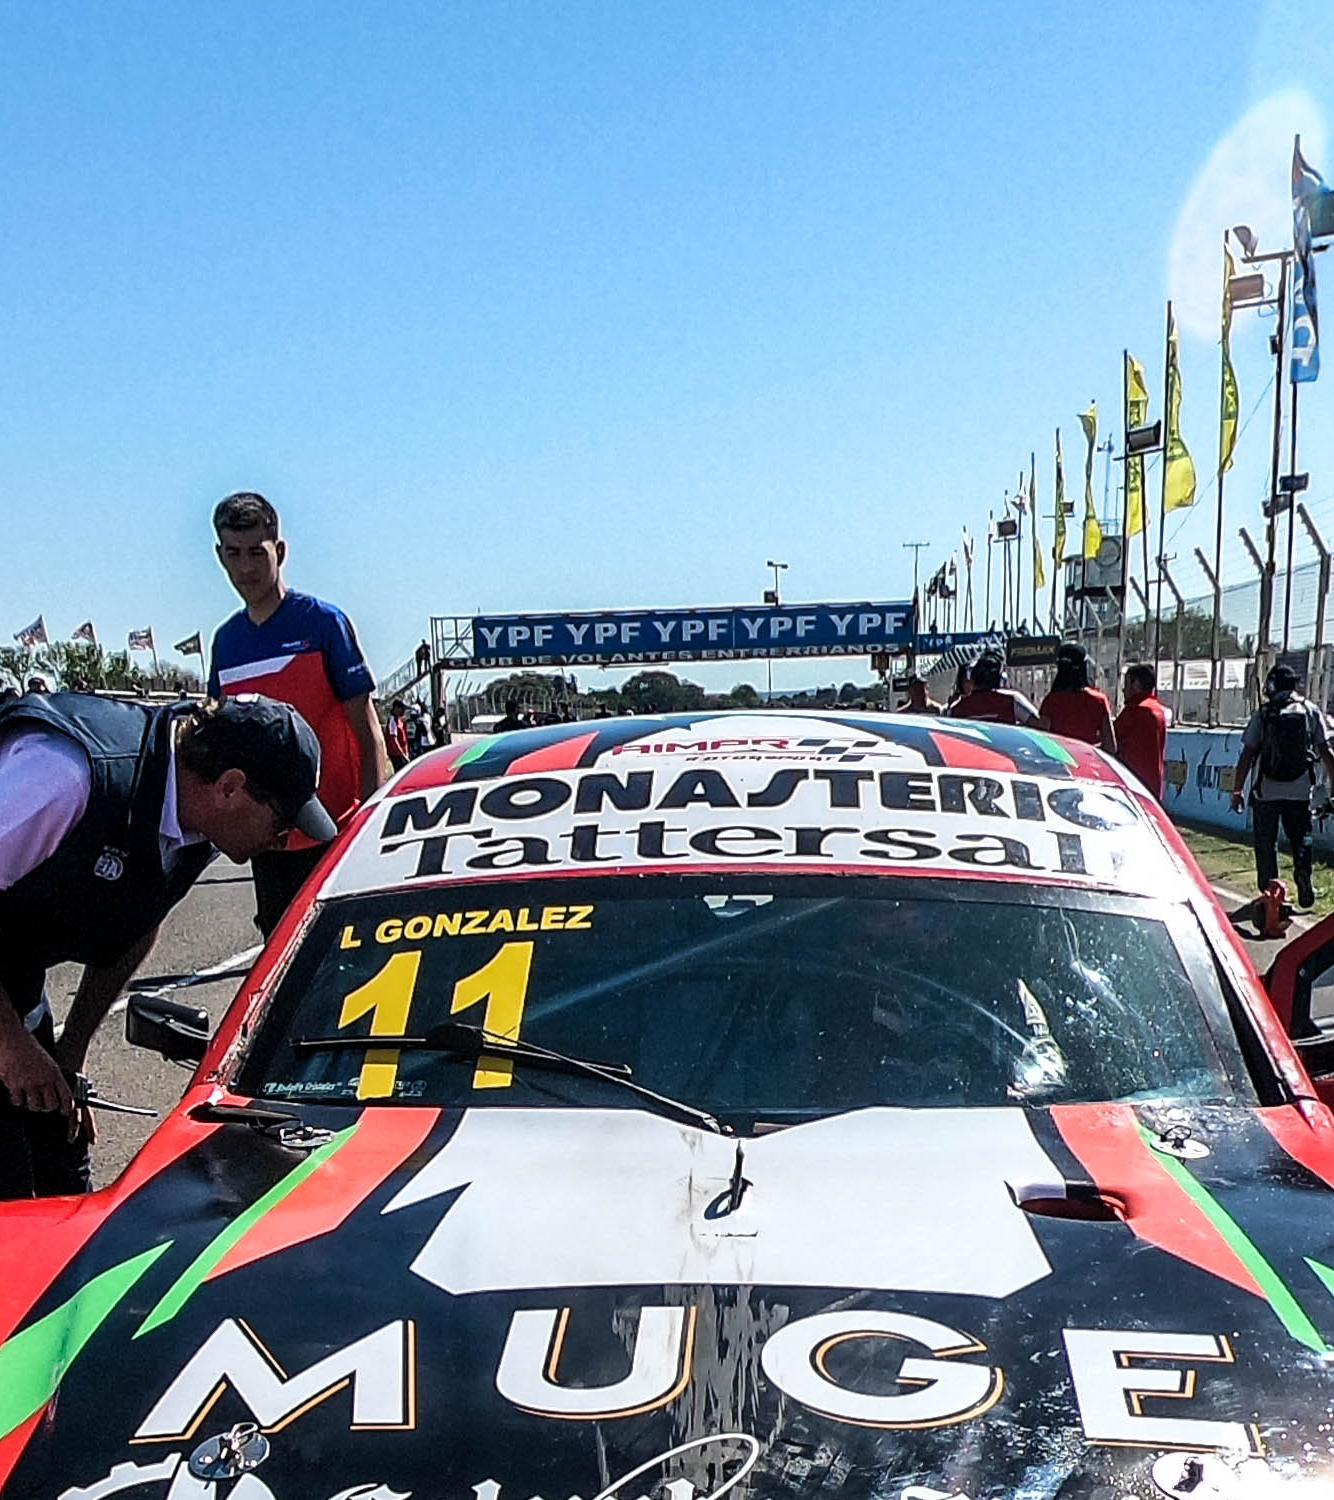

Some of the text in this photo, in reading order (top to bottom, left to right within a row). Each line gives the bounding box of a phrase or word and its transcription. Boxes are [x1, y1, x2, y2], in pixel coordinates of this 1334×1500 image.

[478, 611, 907, 649] YPF YPF YPF YPF YPF
[521, 655, 553, 667] DE
[566, 648, 695, 665] VOLANTES
[705, 642, 900, 660] ENTRERRIANOS
[341, 904, 596, 950] L GONZALEZ
[338, 941, 535, 1101] 11
[129, 1305, 1267, 1458] MUGE
